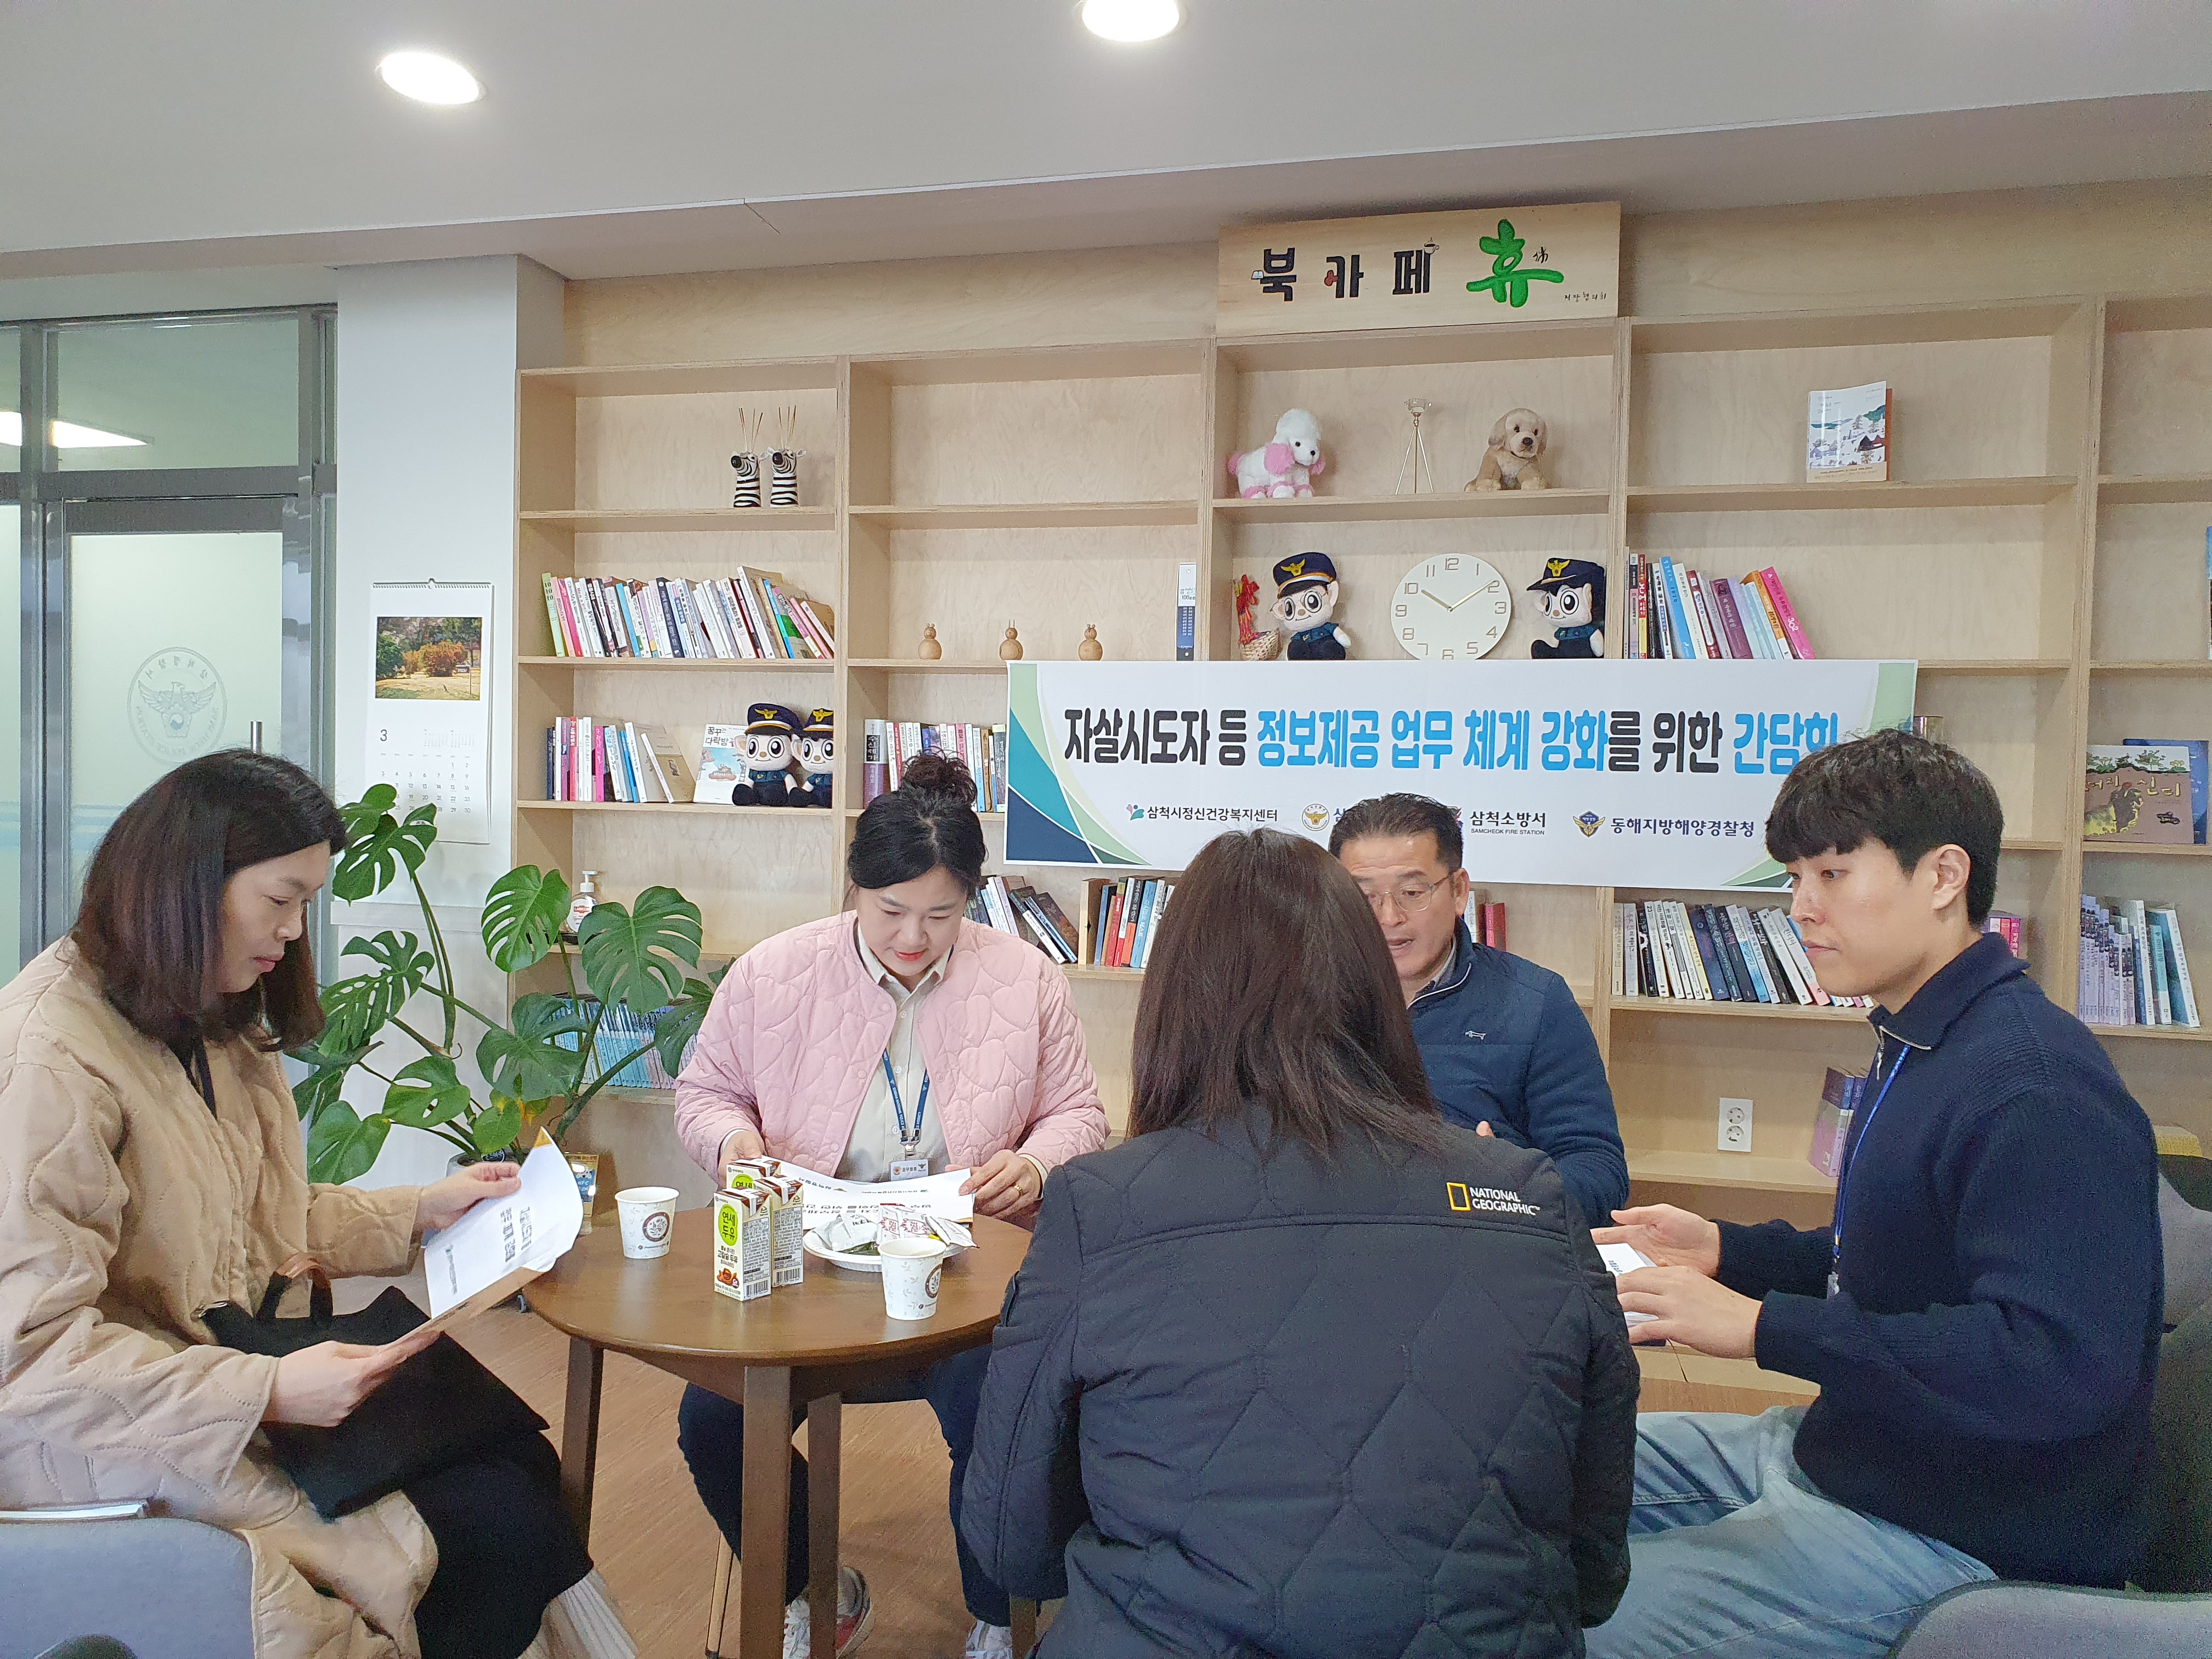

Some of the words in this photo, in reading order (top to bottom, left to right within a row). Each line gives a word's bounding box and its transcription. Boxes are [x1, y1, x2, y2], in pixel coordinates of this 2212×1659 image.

[1466, 219, 1564, 307] 휴
[1445, 558, 1459, 570] 12
[1476, 563, 1479, 575] 1
[1404, 583, 1418, 594] 10
[1395, 605, 1407, 617] 9
[1494, 601, 1506, 614] 3
[1787, 617, 1799, 631] 302
[1403, 628, 1414, 640] 8
[1486, 626, 1497, 638] 4
[1417, 643, 1428, 655] 7
[1466, 642, 1479, 654] 5
[380, 729, 387, 741] 3
[707, 726, 727, 736] 꿈꾸는
[1064, 708, 1210, 766] 자살시도자
[1218, 709, 1246, 765] 등
[1257, 709, 1379, 768] 정보제공
[1391, 709, 1452, 769] 업무
[1463, 709, 1530, 770] 체계
[1541, 709, 1641, 772] 강화를
[1652, 711, 1723, 774] 위한
[2136, 775, 2181, 797] 신디
[1147, 805, 1278, 823] 삼척시정신건강복지센터
[1469, 810, 1546, 829] 삼척소방서
[1610, 817, 1754, 837] 동해지방해양경찰청
[1469, 1187, 1521, 1203] NATIONAL
[1472, 1199, 1537, 1215] GEOGRAPHIC
[723, 1212, 735, 1226] 연세
[722, 1225, 735, 1240] 두유
